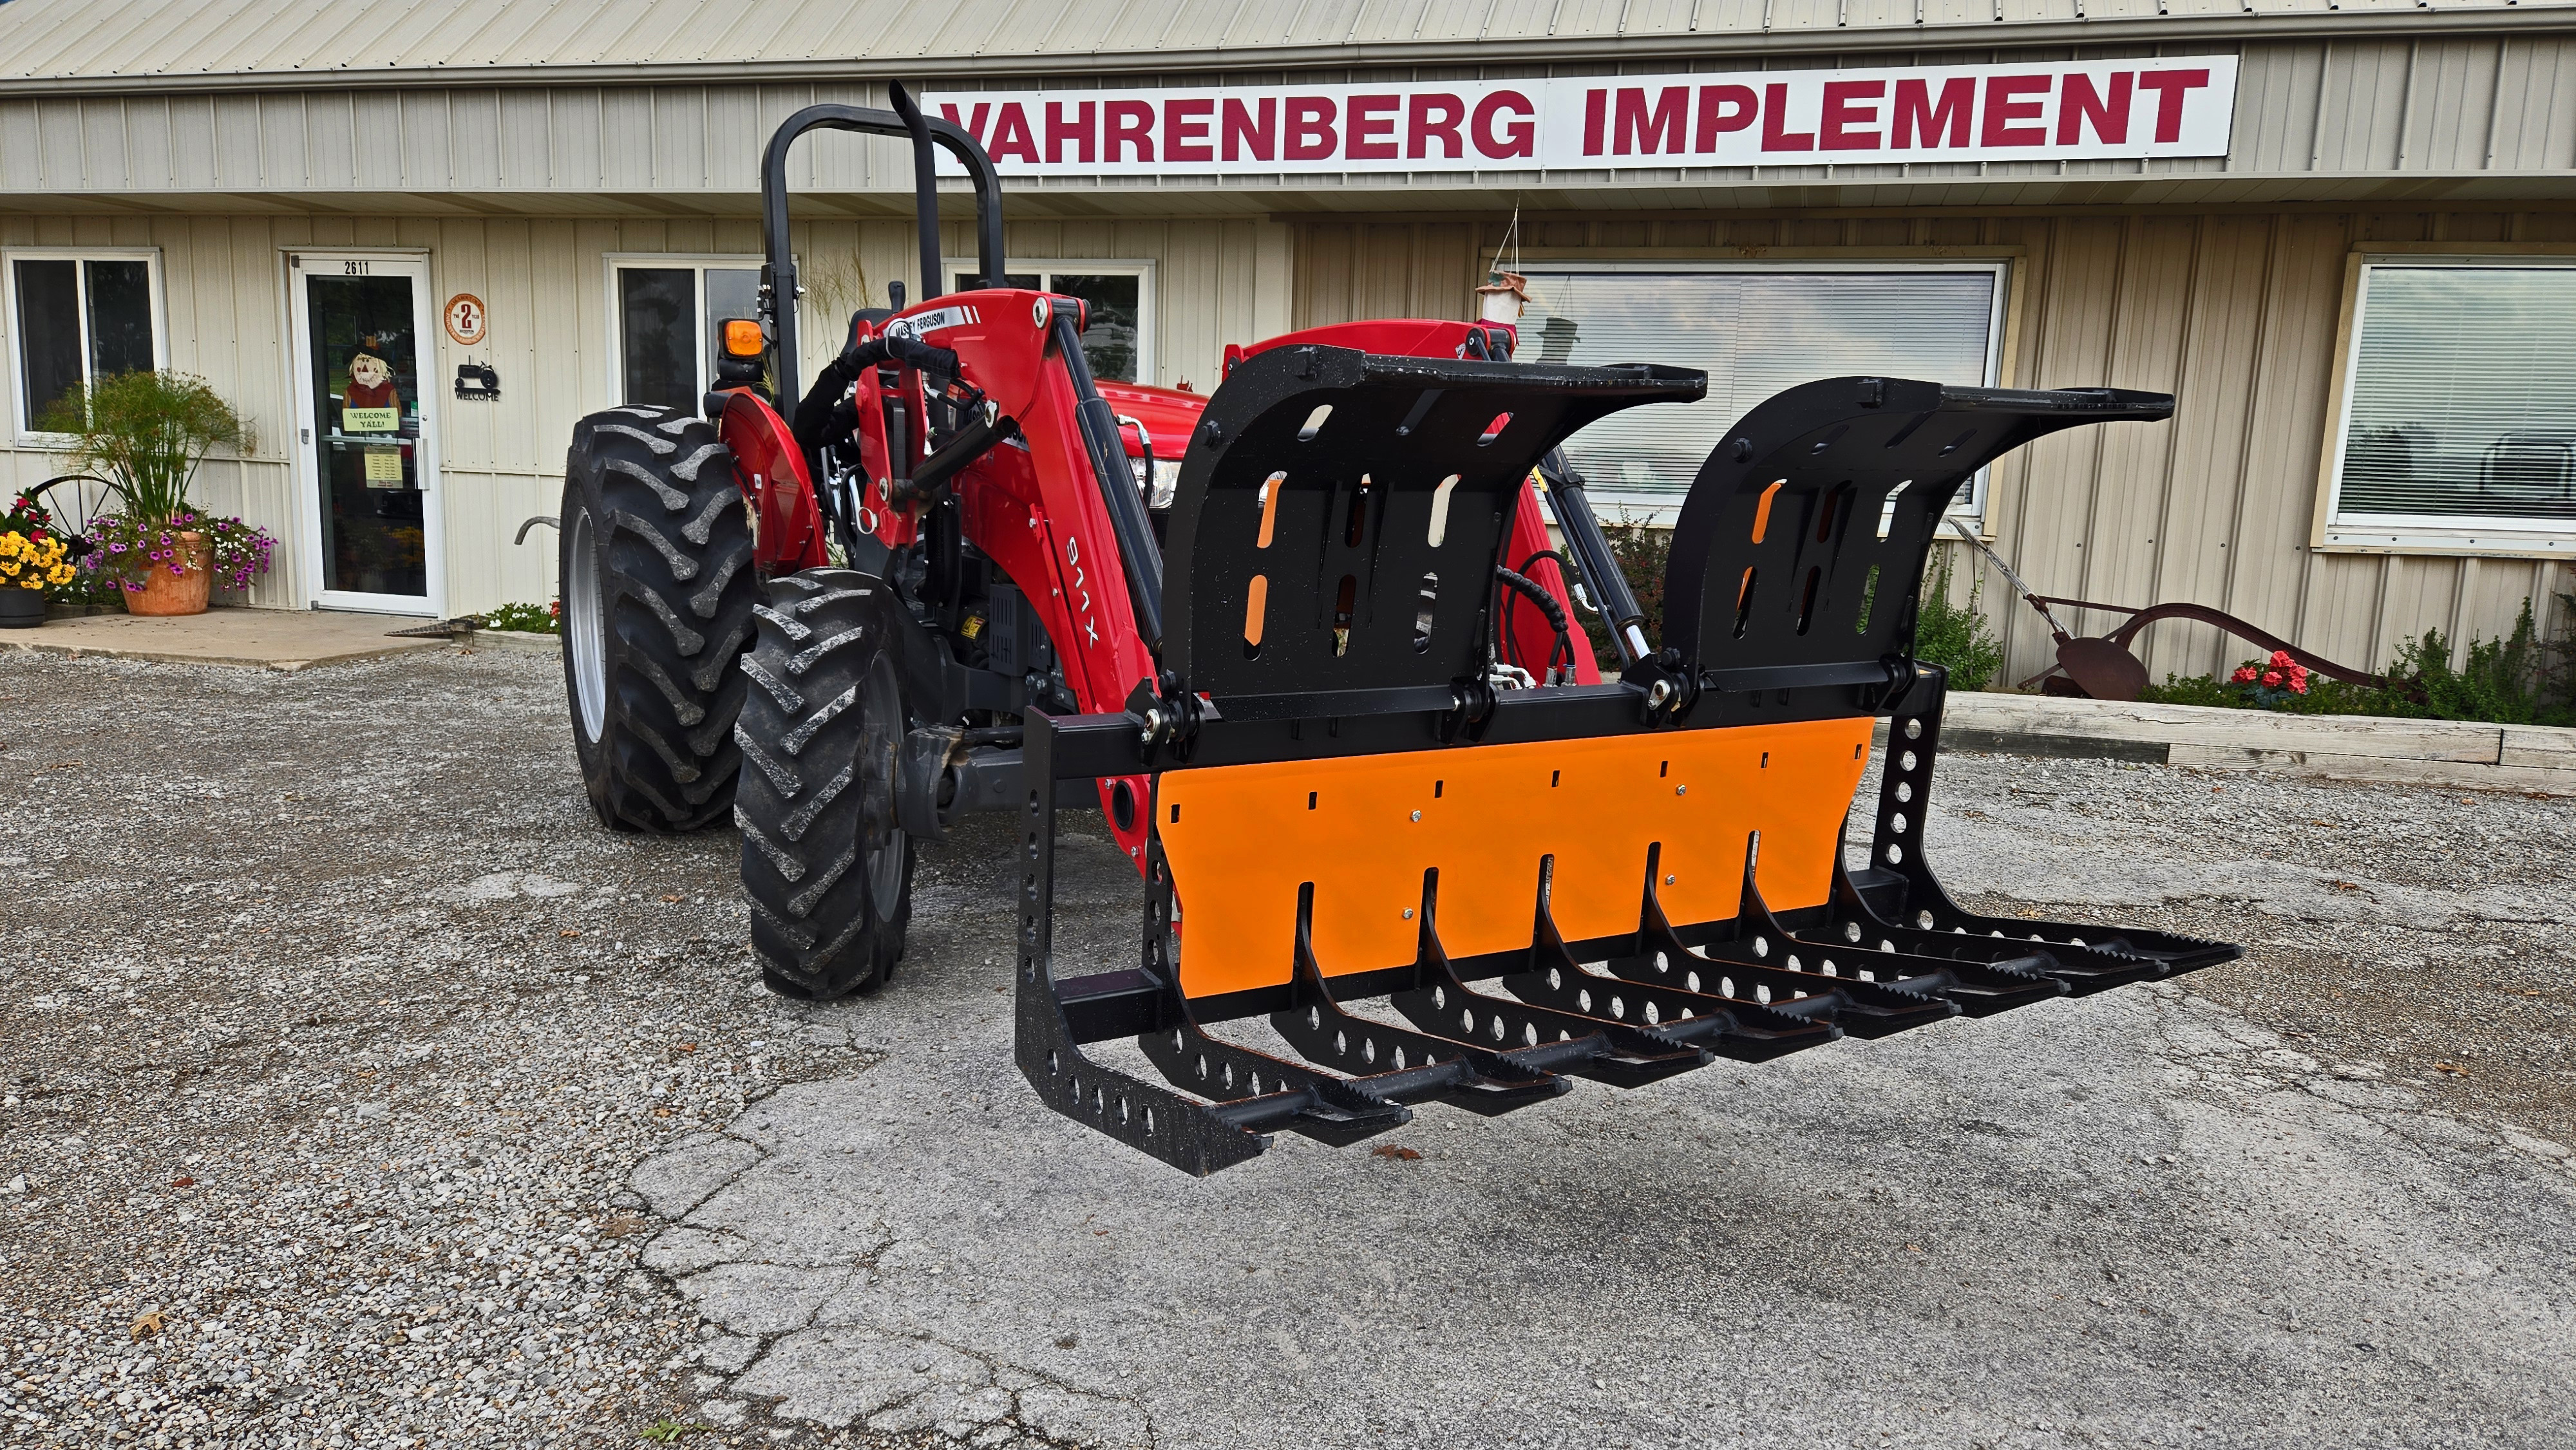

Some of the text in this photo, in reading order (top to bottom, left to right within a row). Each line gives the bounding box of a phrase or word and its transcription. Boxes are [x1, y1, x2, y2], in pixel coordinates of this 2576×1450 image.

[940, 69, 2210, 164] VAHRENBERG IMPLEMENT
[345, 261, 368, 274] 2611
[461, 304, 471, 328] 2
[917, 312, 945, 330] FERGUSON
[455, 391, 498, 401] WELCOME
